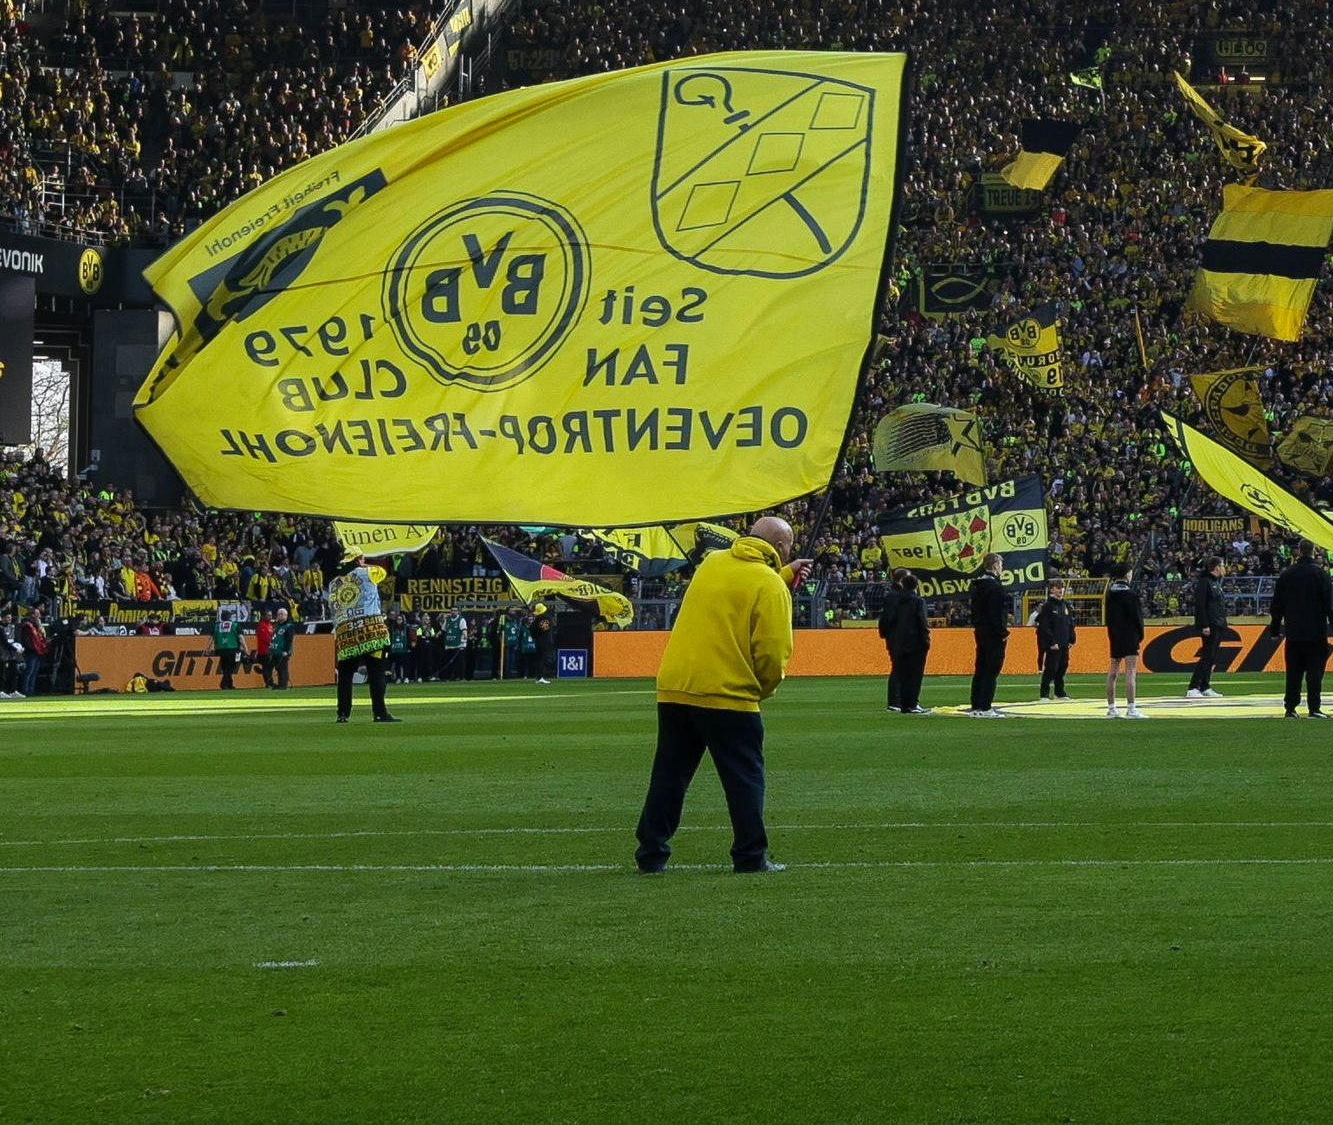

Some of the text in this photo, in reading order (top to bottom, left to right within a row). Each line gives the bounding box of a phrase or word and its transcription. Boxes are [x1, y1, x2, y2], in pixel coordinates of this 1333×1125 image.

[1183, 517, 1245, 532] HOOLIGANS
[406, 577, 503, 594] RENNSTEIG
[152, 649, 264, 678] GITTNS
[560, 655, 584, 671] 1&1
